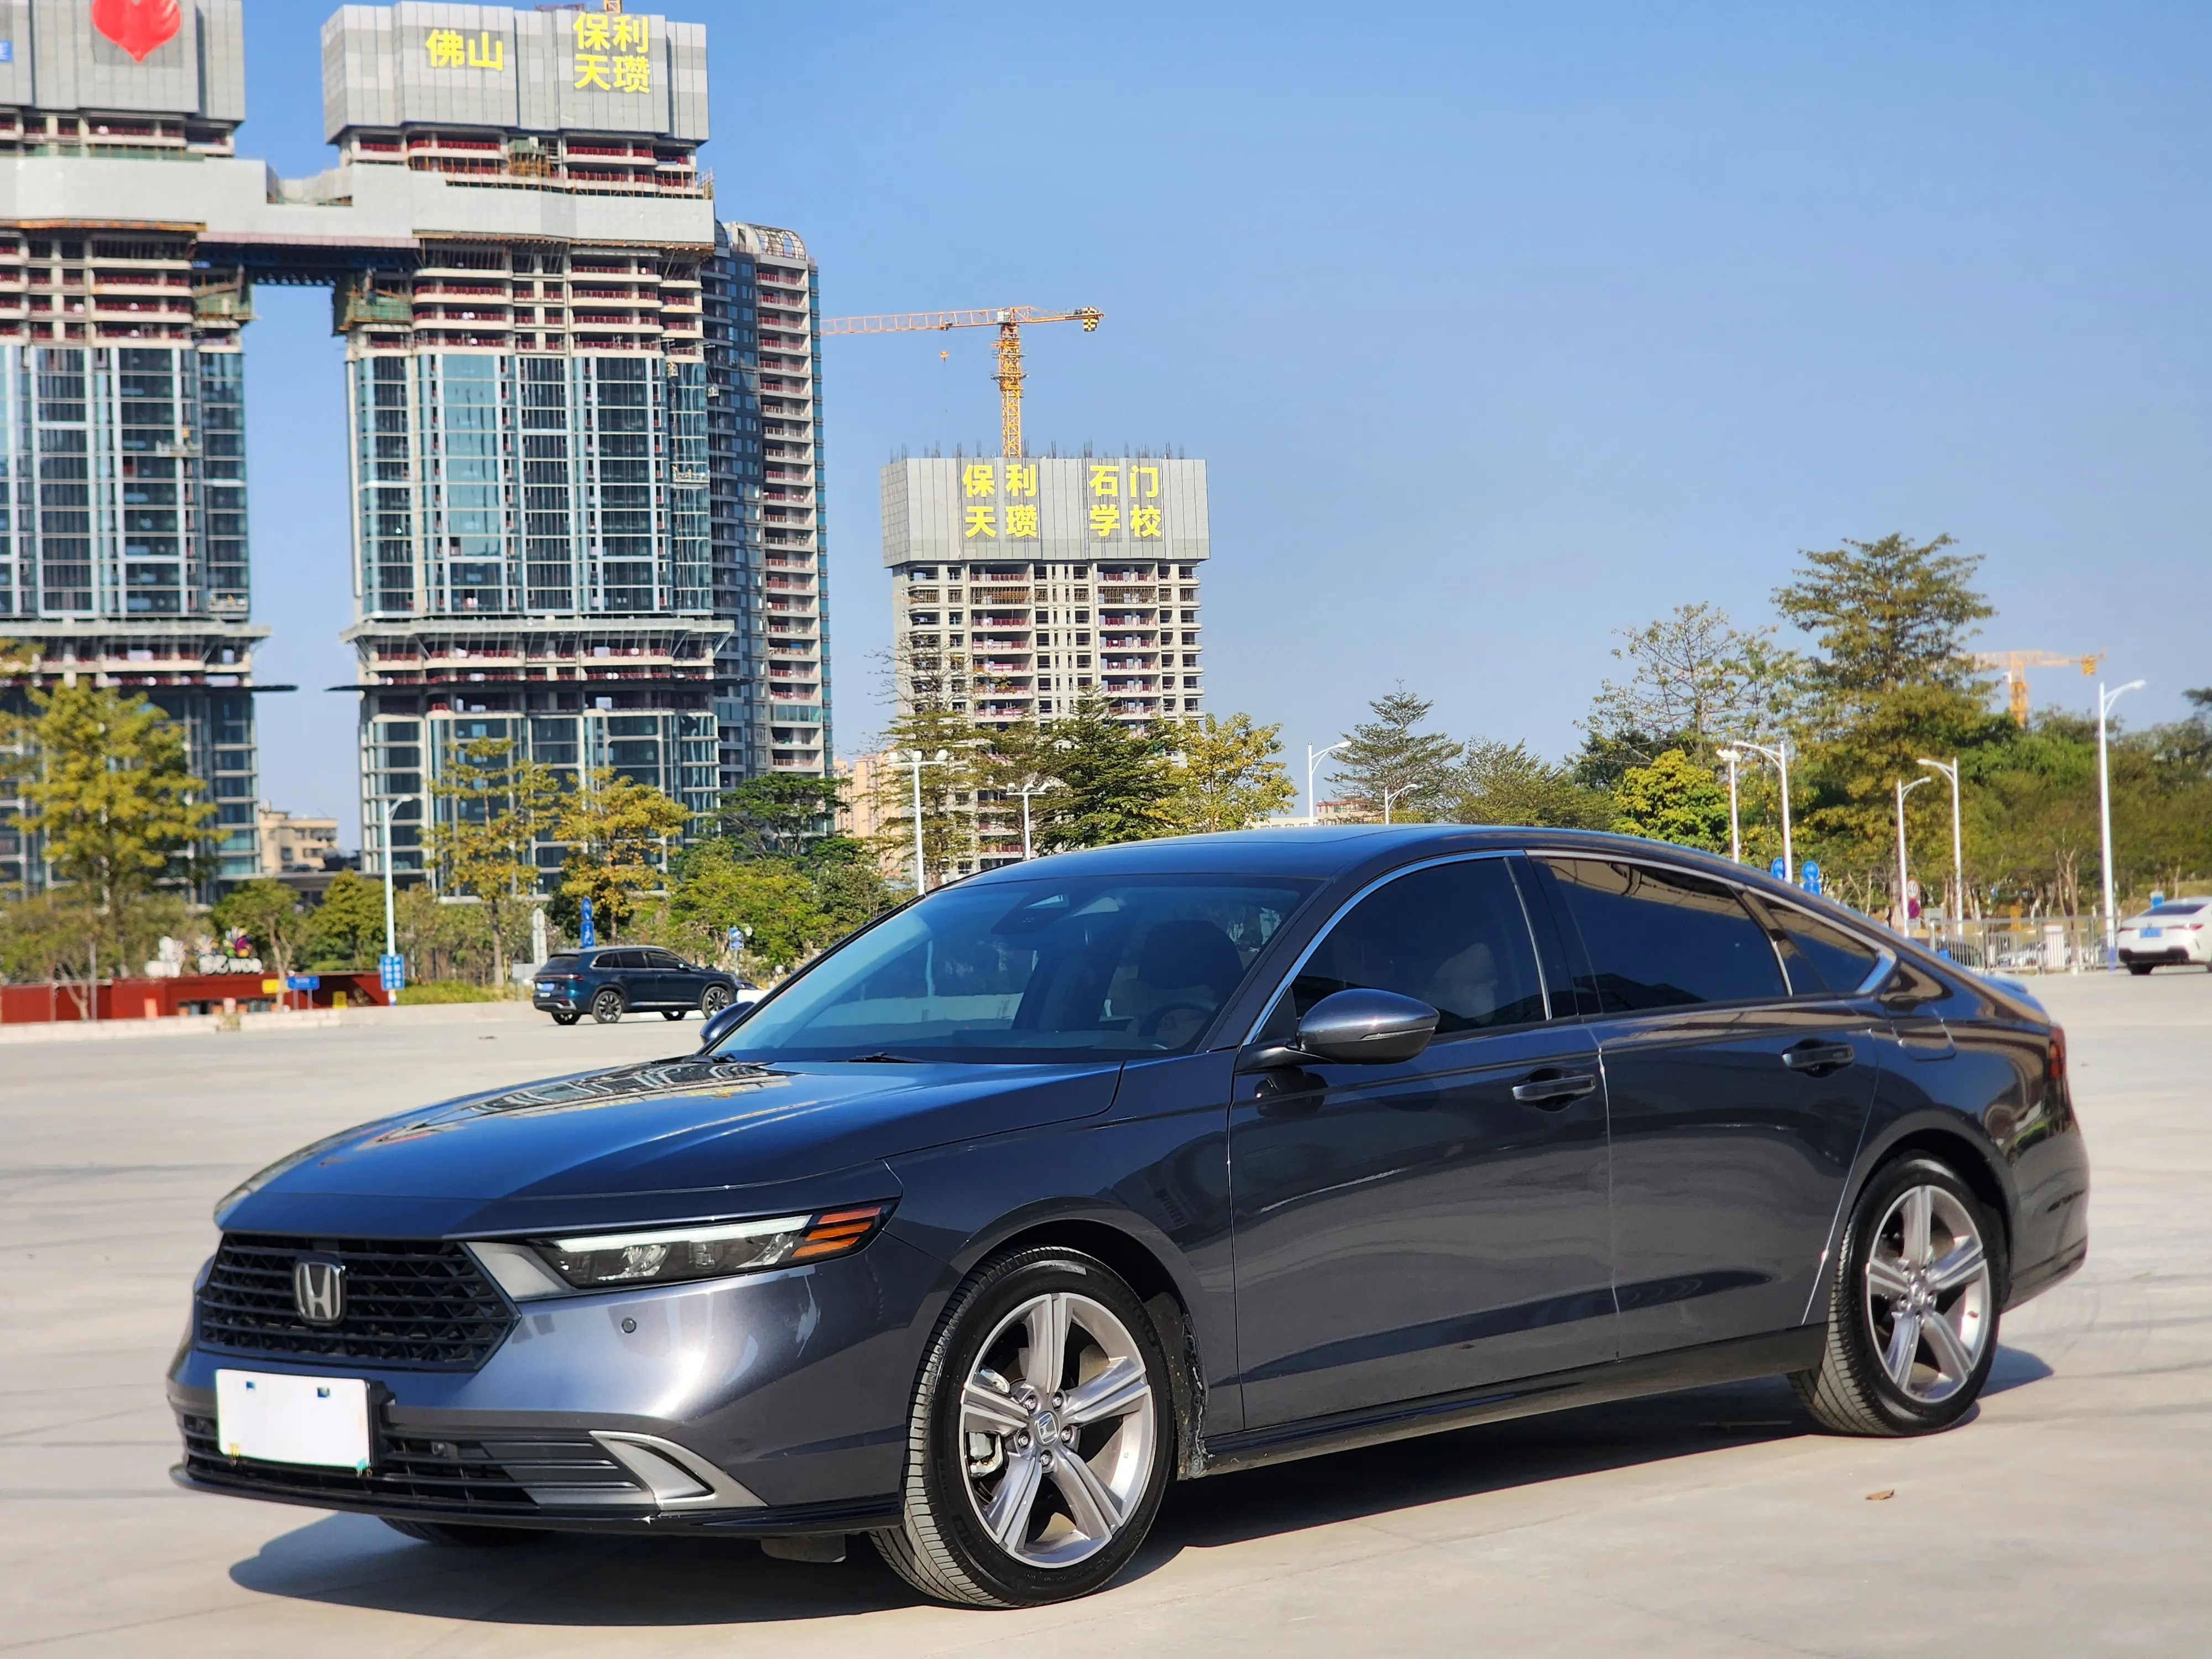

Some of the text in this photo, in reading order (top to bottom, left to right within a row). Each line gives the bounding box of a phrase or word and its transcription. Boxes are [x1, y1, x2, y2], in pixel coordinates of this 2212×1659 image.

[425, 29, 503, 71] 佛山
[573, 13, 648, 53] 保利
[963, 465, 1037, 498] 保利
[1089, 465, 1159, 498] 石门
[1090, 504, 1162, 538] 学校
